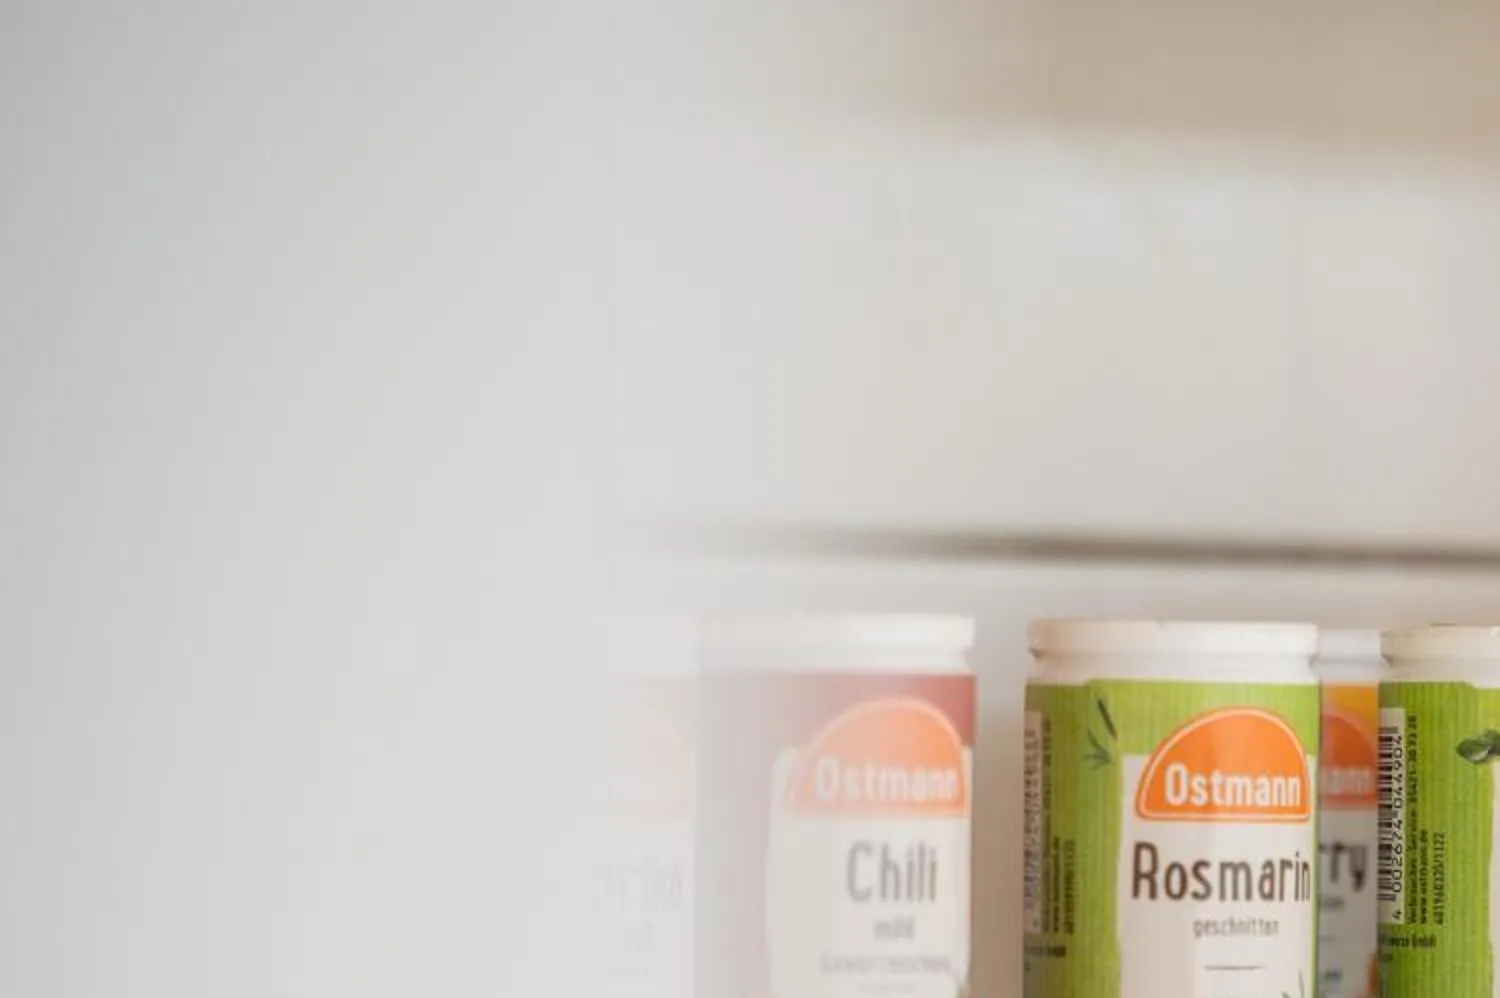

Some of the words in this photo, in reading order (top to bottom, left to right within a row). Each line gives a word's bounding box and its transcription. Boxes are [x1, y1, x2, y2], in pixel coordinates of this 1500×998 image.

[816, 756, 958, 800] Ostmann
[1163, 761, 1302, 808] Ostmann
[846, 840, 938, 903] Chili
[1132, 840, 1312, 902] Rosmarin
[1391, 819, 1403, 893] 002674
[1192, 916, 1280, 938] geschnitten
